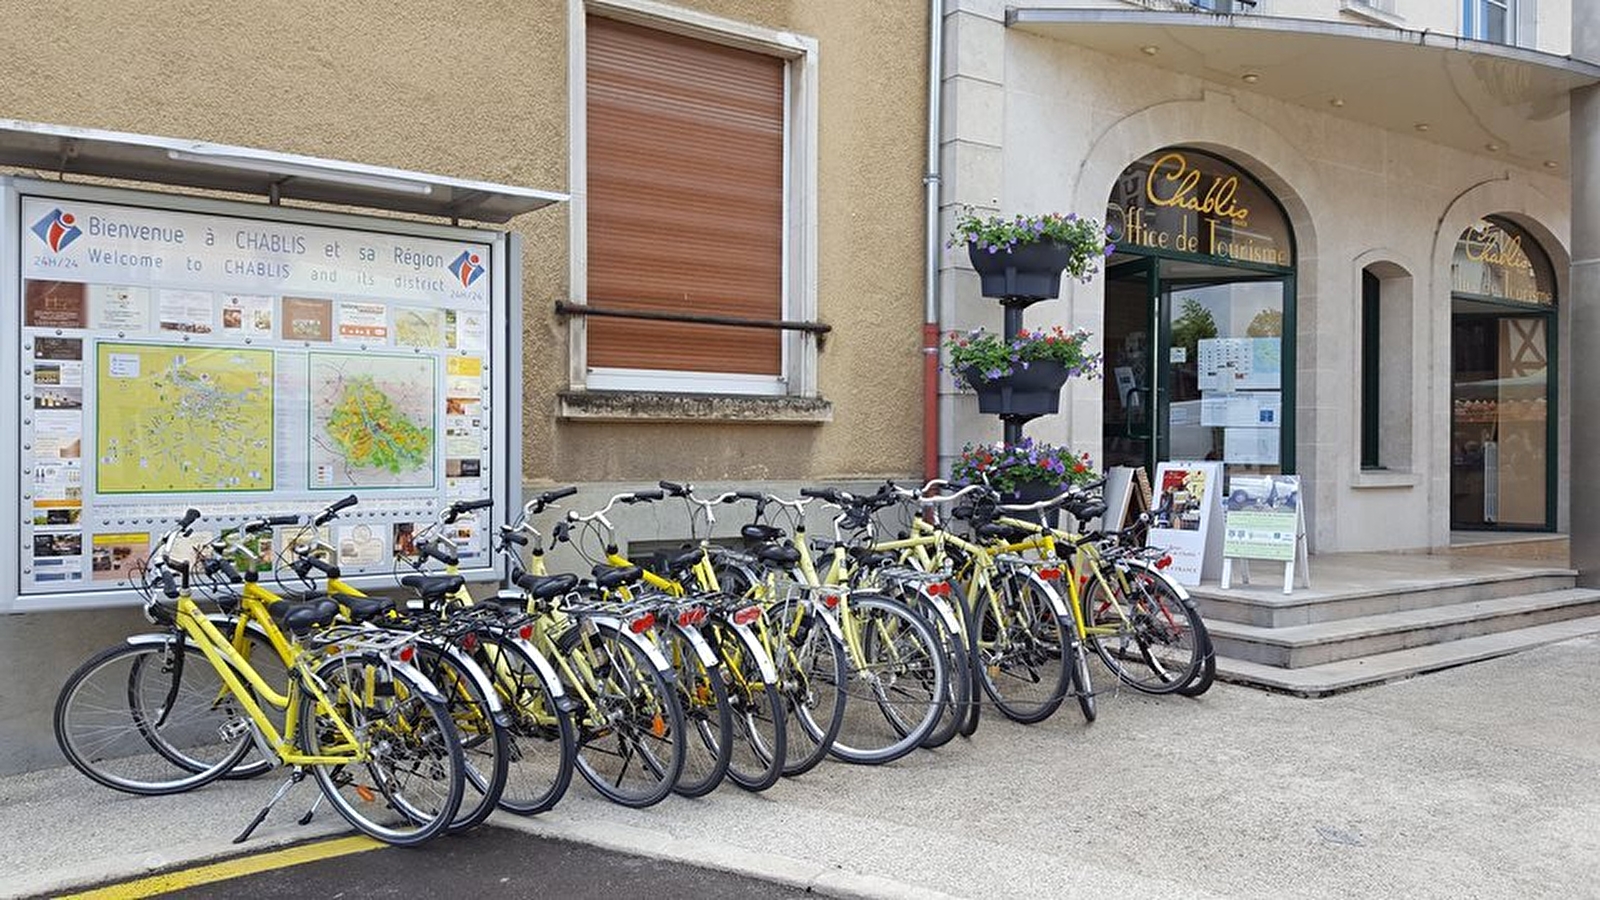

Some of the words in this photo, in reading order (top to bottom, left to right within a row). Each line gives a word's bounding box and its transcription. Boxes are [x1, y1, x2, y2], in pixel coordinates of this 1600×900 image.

[1147, 154, 1248, 219] Chablis
[89, 216, 184, 243] Bienvenue
[205, 228, 214, 246] à
[235, 230, 306, 255] CHABLIS
[325, 241, 340, 258] et
[359, 247, 375, 261] sa
[394, 246, 443, 270] Région
[1105, 202, 1168, 249] Office
[1175, 214, 1199, 253] de
[1204, 218, 1286, 265] Tourisme
[1466, 221, 1528, 268] Chablis
[34, 255, 79, 269] 24H/24
[88, 248, 163, 268] Welcome
[187, 257, 202, 271] to
[224, 259, 290, 279] CHABLIS
[310, 269, 337, 282] and
[394, 276, 445, 293] district
